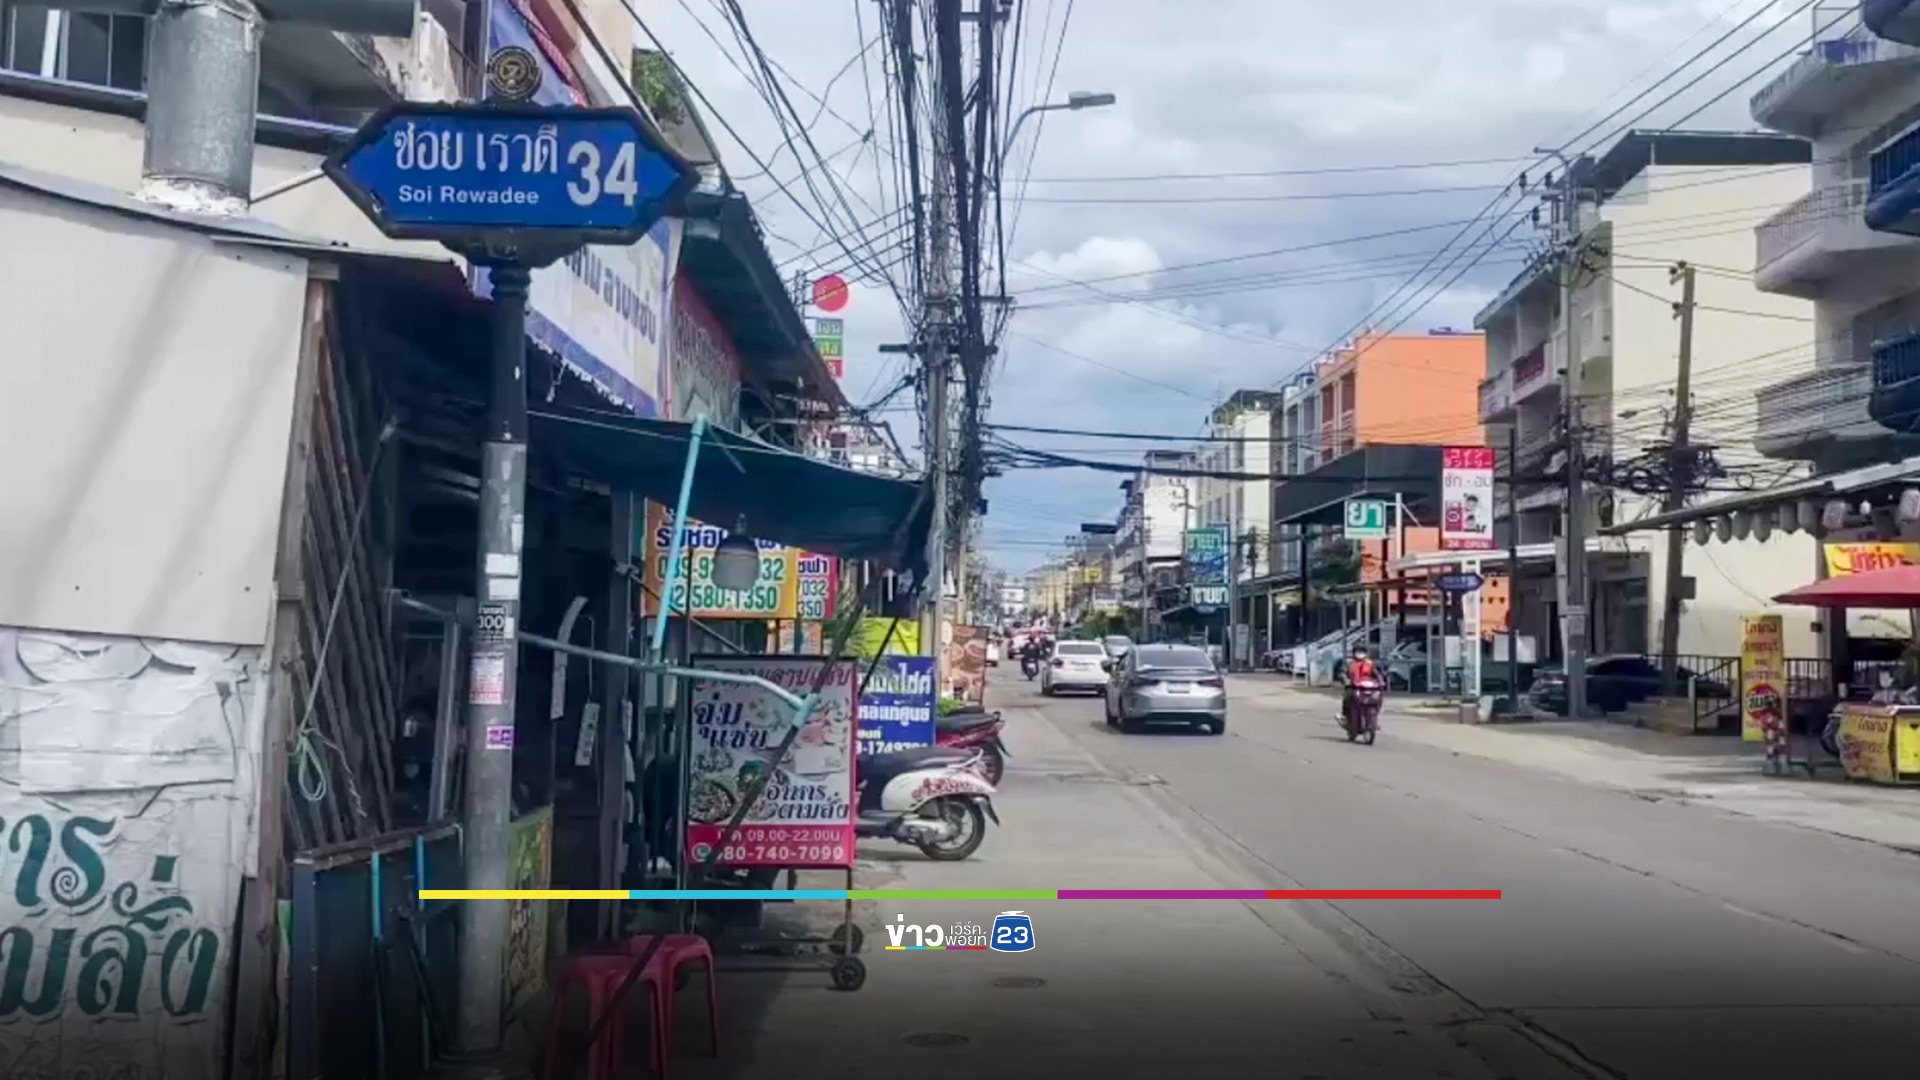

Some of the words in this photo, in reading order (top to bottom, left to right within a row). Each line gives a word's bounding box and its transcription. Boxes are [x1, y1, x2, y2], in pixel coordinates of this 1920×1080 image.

[476, 124, 559, 175] เรวดี
[566, 141, 638, 207] 34
[398, 185, 433, 203] Soi
[440, 186, 539, 205] Rewadee
[1347, 502, 1383, 527] ยา
